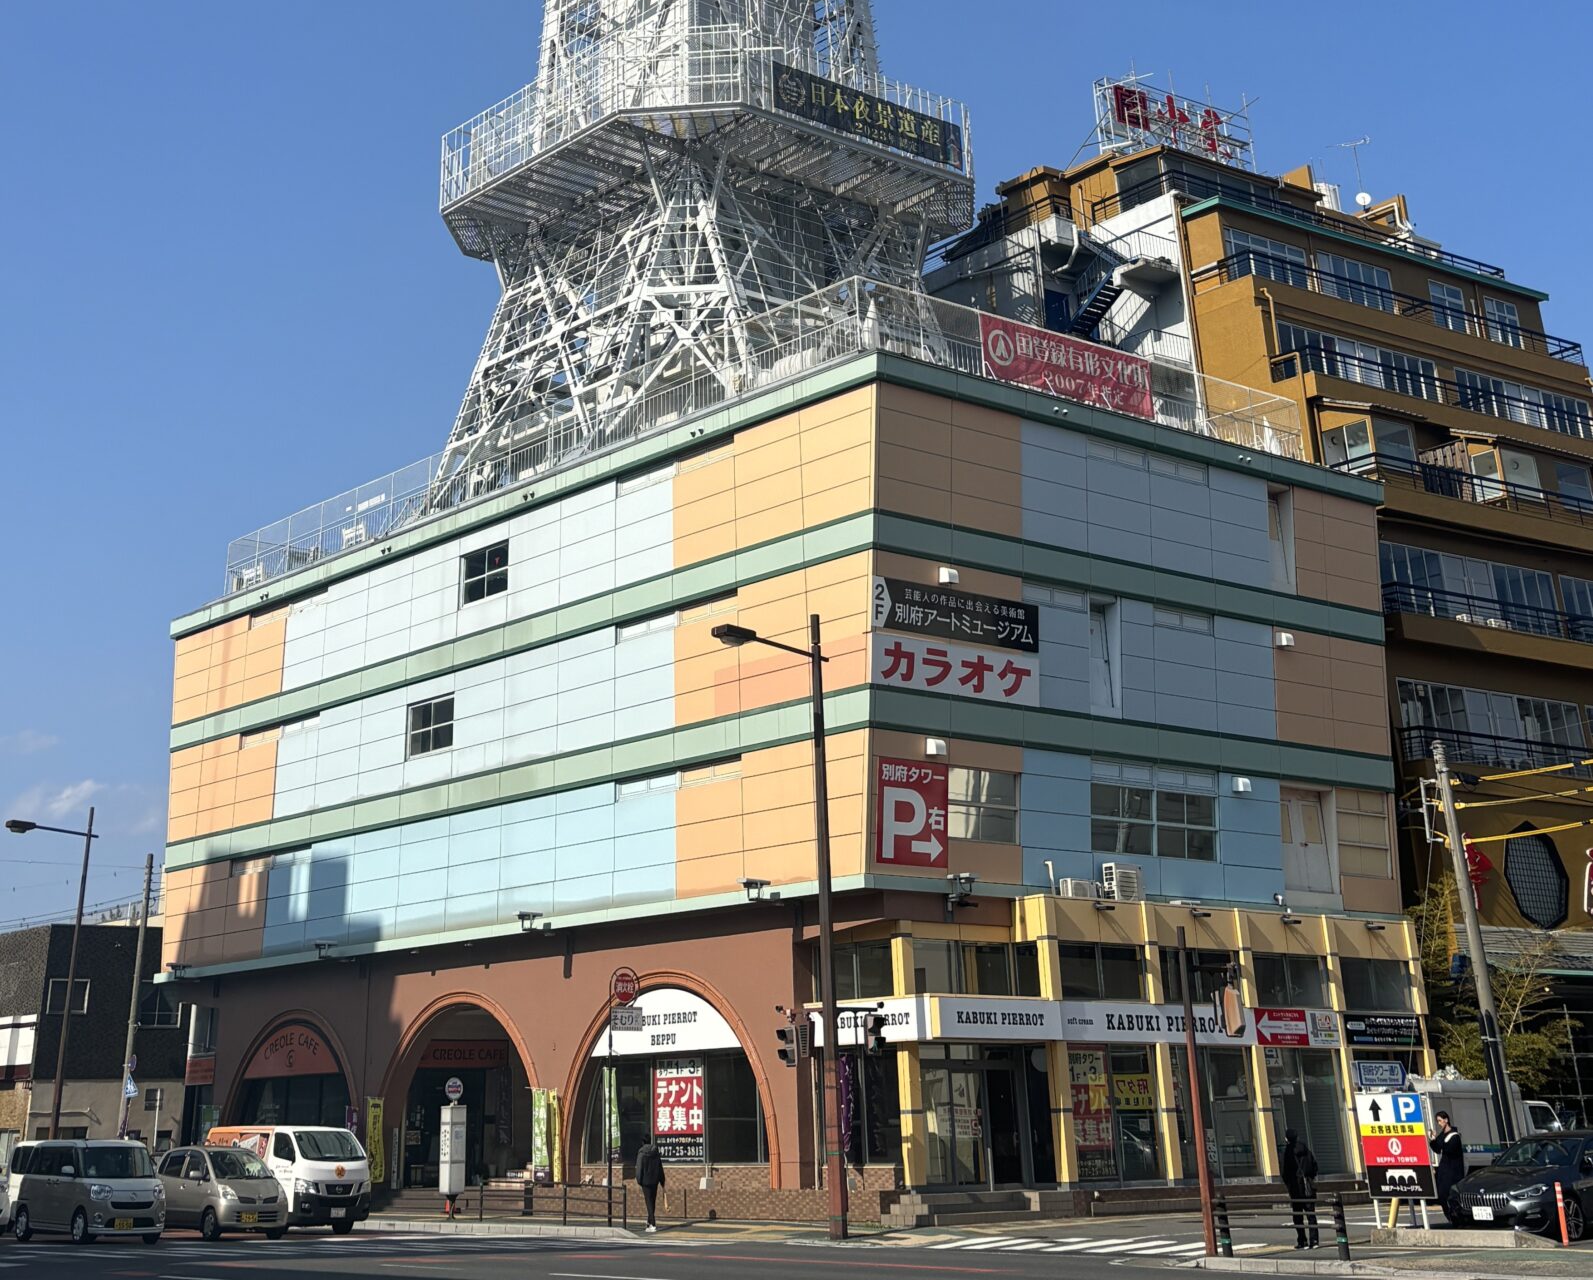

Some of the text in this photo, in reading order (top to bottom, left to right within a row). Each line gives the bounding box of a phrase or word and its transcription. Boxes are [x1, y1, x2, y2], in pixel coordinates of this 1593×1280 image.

[810, 81, 941, 147] 日本夜景遺産
[1015, 331, 1149, 390] 国登録有形文化財
[1041, 370, 1127, 405] 2007年指定
[904, 588, 1025, 620] 芸能人の作品に出会える美術館
[895, 602, 1034, 645] 別府アートミュージアム
[880, 640, 1032, 698] カラオケ
[881, 763, 945, 784] 別府タワー
[881, 785, 927, 859] P
[928, 806, 946, 831] 右
[642, 1011, 698, 1027] BUKI PIERROT
[956, 1011, 1045, 1026] KABUKI PIERROT
[1105, 1013, 1162, 1032] KABUKI
[263, 1032, 320, 1060] CREOLE CAFE
[650, 1033, 677, 1046] BEPPU
[432, 1048, 505, 1060] CREOLE CAFE
[1362, 1064, 1399, 1076] 別府タワー通り
[656, 1078, 703, 1105] テナント
[656, 1106, 703, 1131] 募集中
[1397, 1096, 1416, 1121] P
[1370, 1124, 1415, 1134] お客様駐車場
